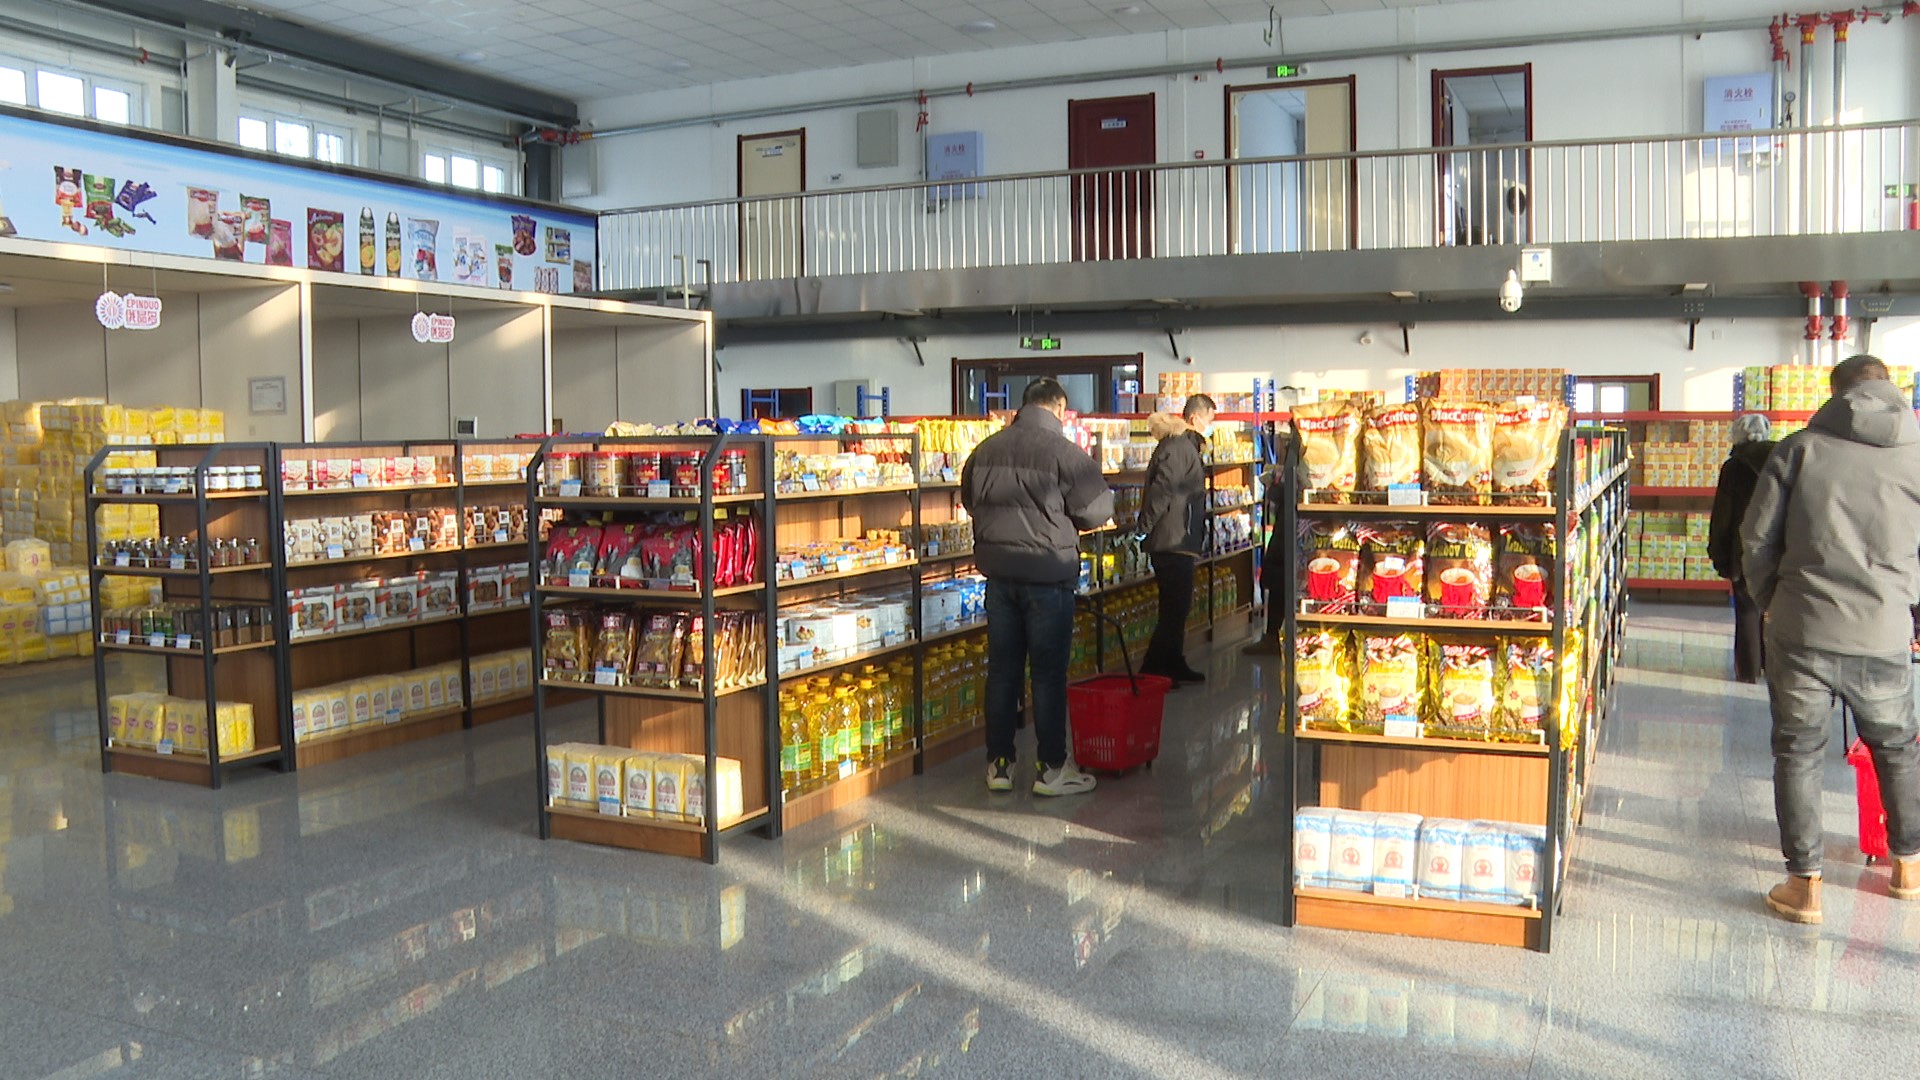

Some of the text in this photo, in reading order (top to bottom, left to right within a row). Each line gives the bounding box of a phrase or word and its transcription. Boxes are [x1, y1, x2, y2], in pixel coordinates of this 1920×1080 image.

[1724, 88, 1753, 98] 消火栓
[126, 299, 159, 310] EPINDUO
